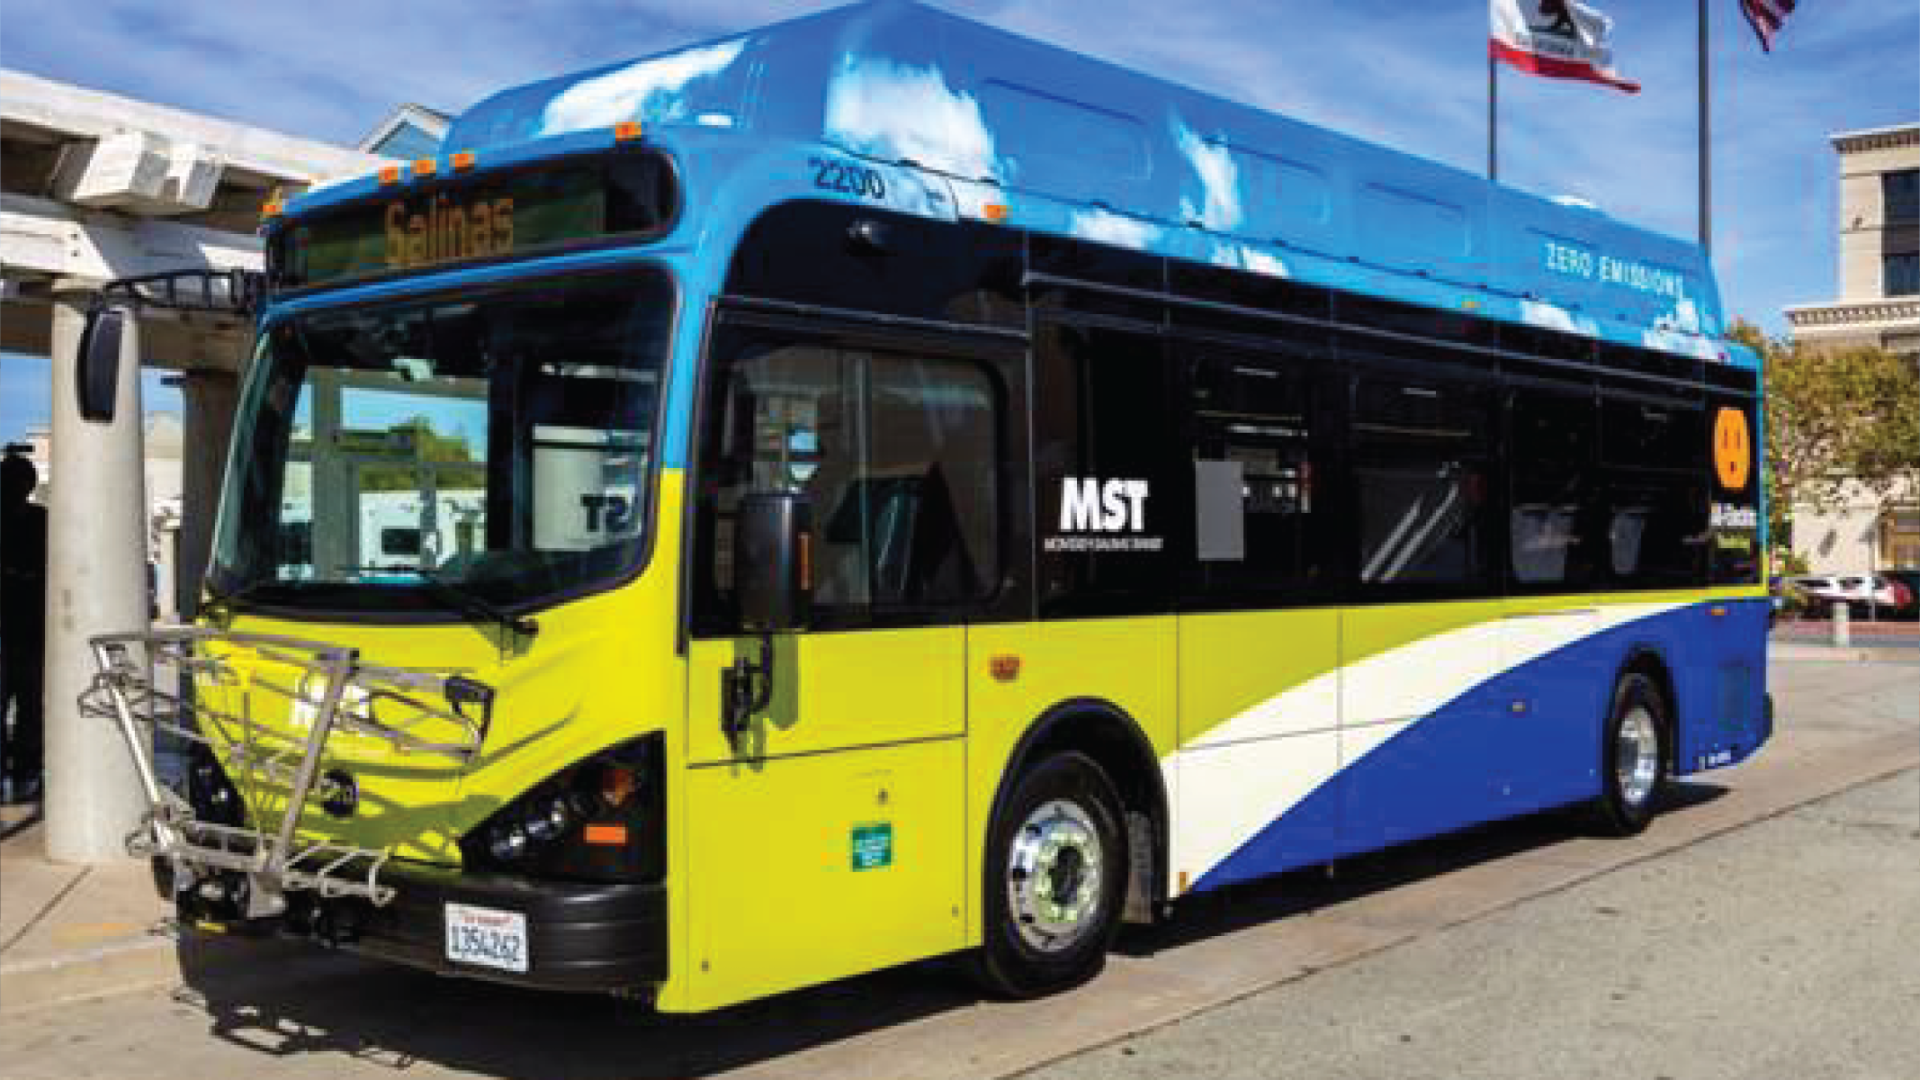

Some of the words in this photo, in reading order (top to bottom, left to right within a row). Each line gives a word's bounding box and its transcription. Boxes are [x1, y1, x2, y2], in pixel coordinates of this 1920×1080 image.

[808, 156, 885, 199] 2200
[385, 200, 514, 269] Salinas
[1545, 243, 1591, 279] ZERO
[1599, 256, 1684, 298] EMISSIONS
[1060, 477, 1149, 533] MST
